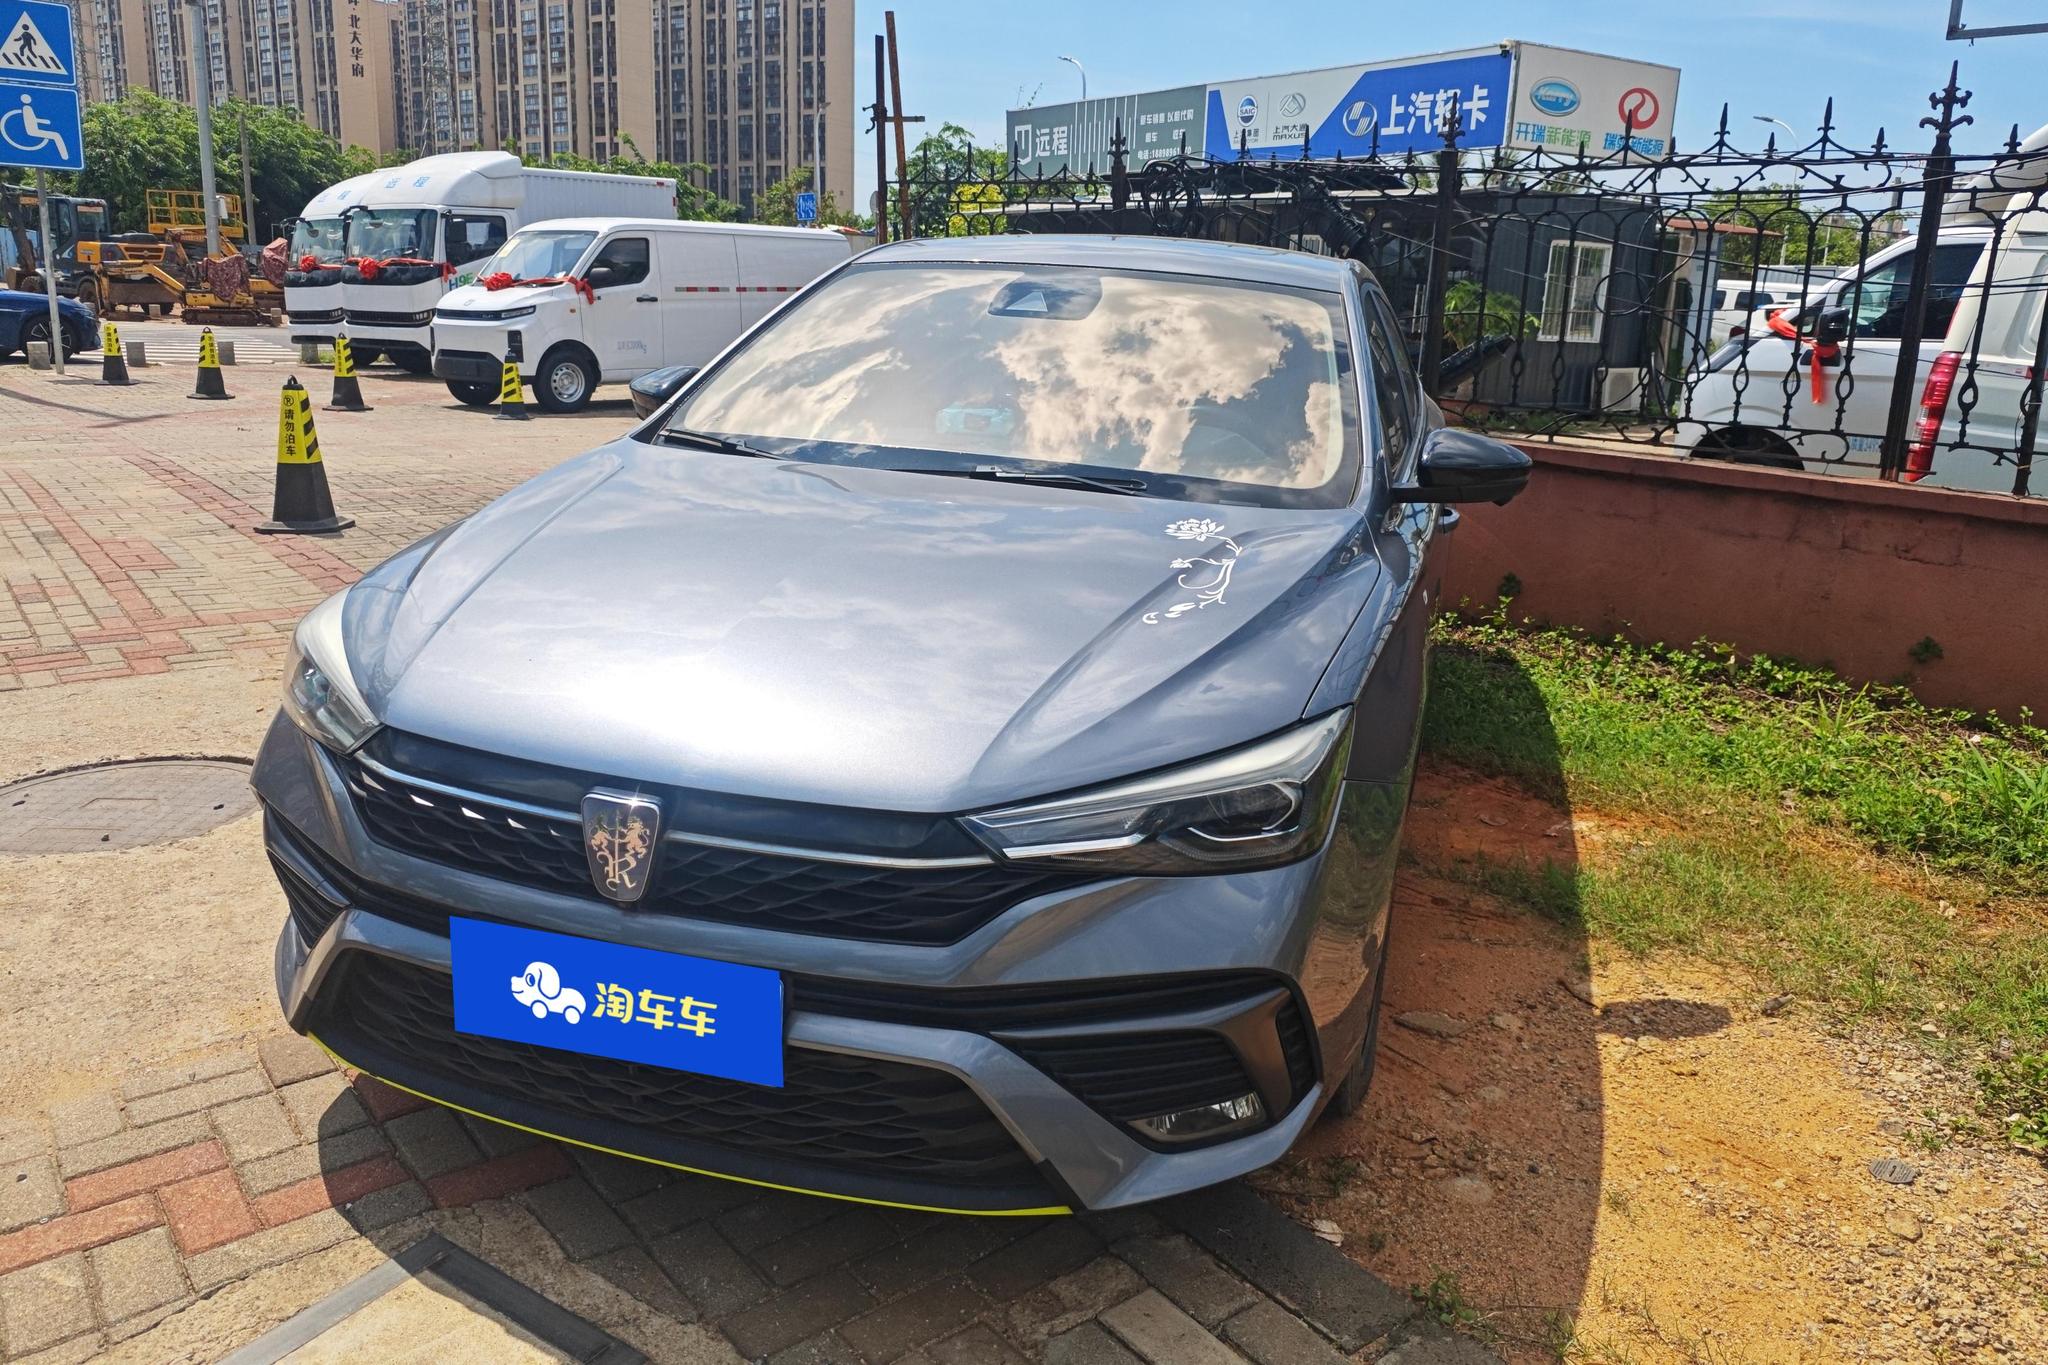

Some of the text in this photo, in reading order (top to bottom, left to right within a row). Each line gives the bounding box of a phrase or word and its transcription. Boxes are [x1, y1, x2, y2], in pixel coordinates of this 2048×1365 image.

[1240, 107, 1256, 115] SAIC
[1380, 84, 1490, 136] 上汽轻卡
[1035, 126, 1068, 157] 远程
[1233, 128, 1260, 139] 上集团
[1516, 121, 1592, 149] 开瑞新能源
[284, 408, 297, 457] 请勿泊车
